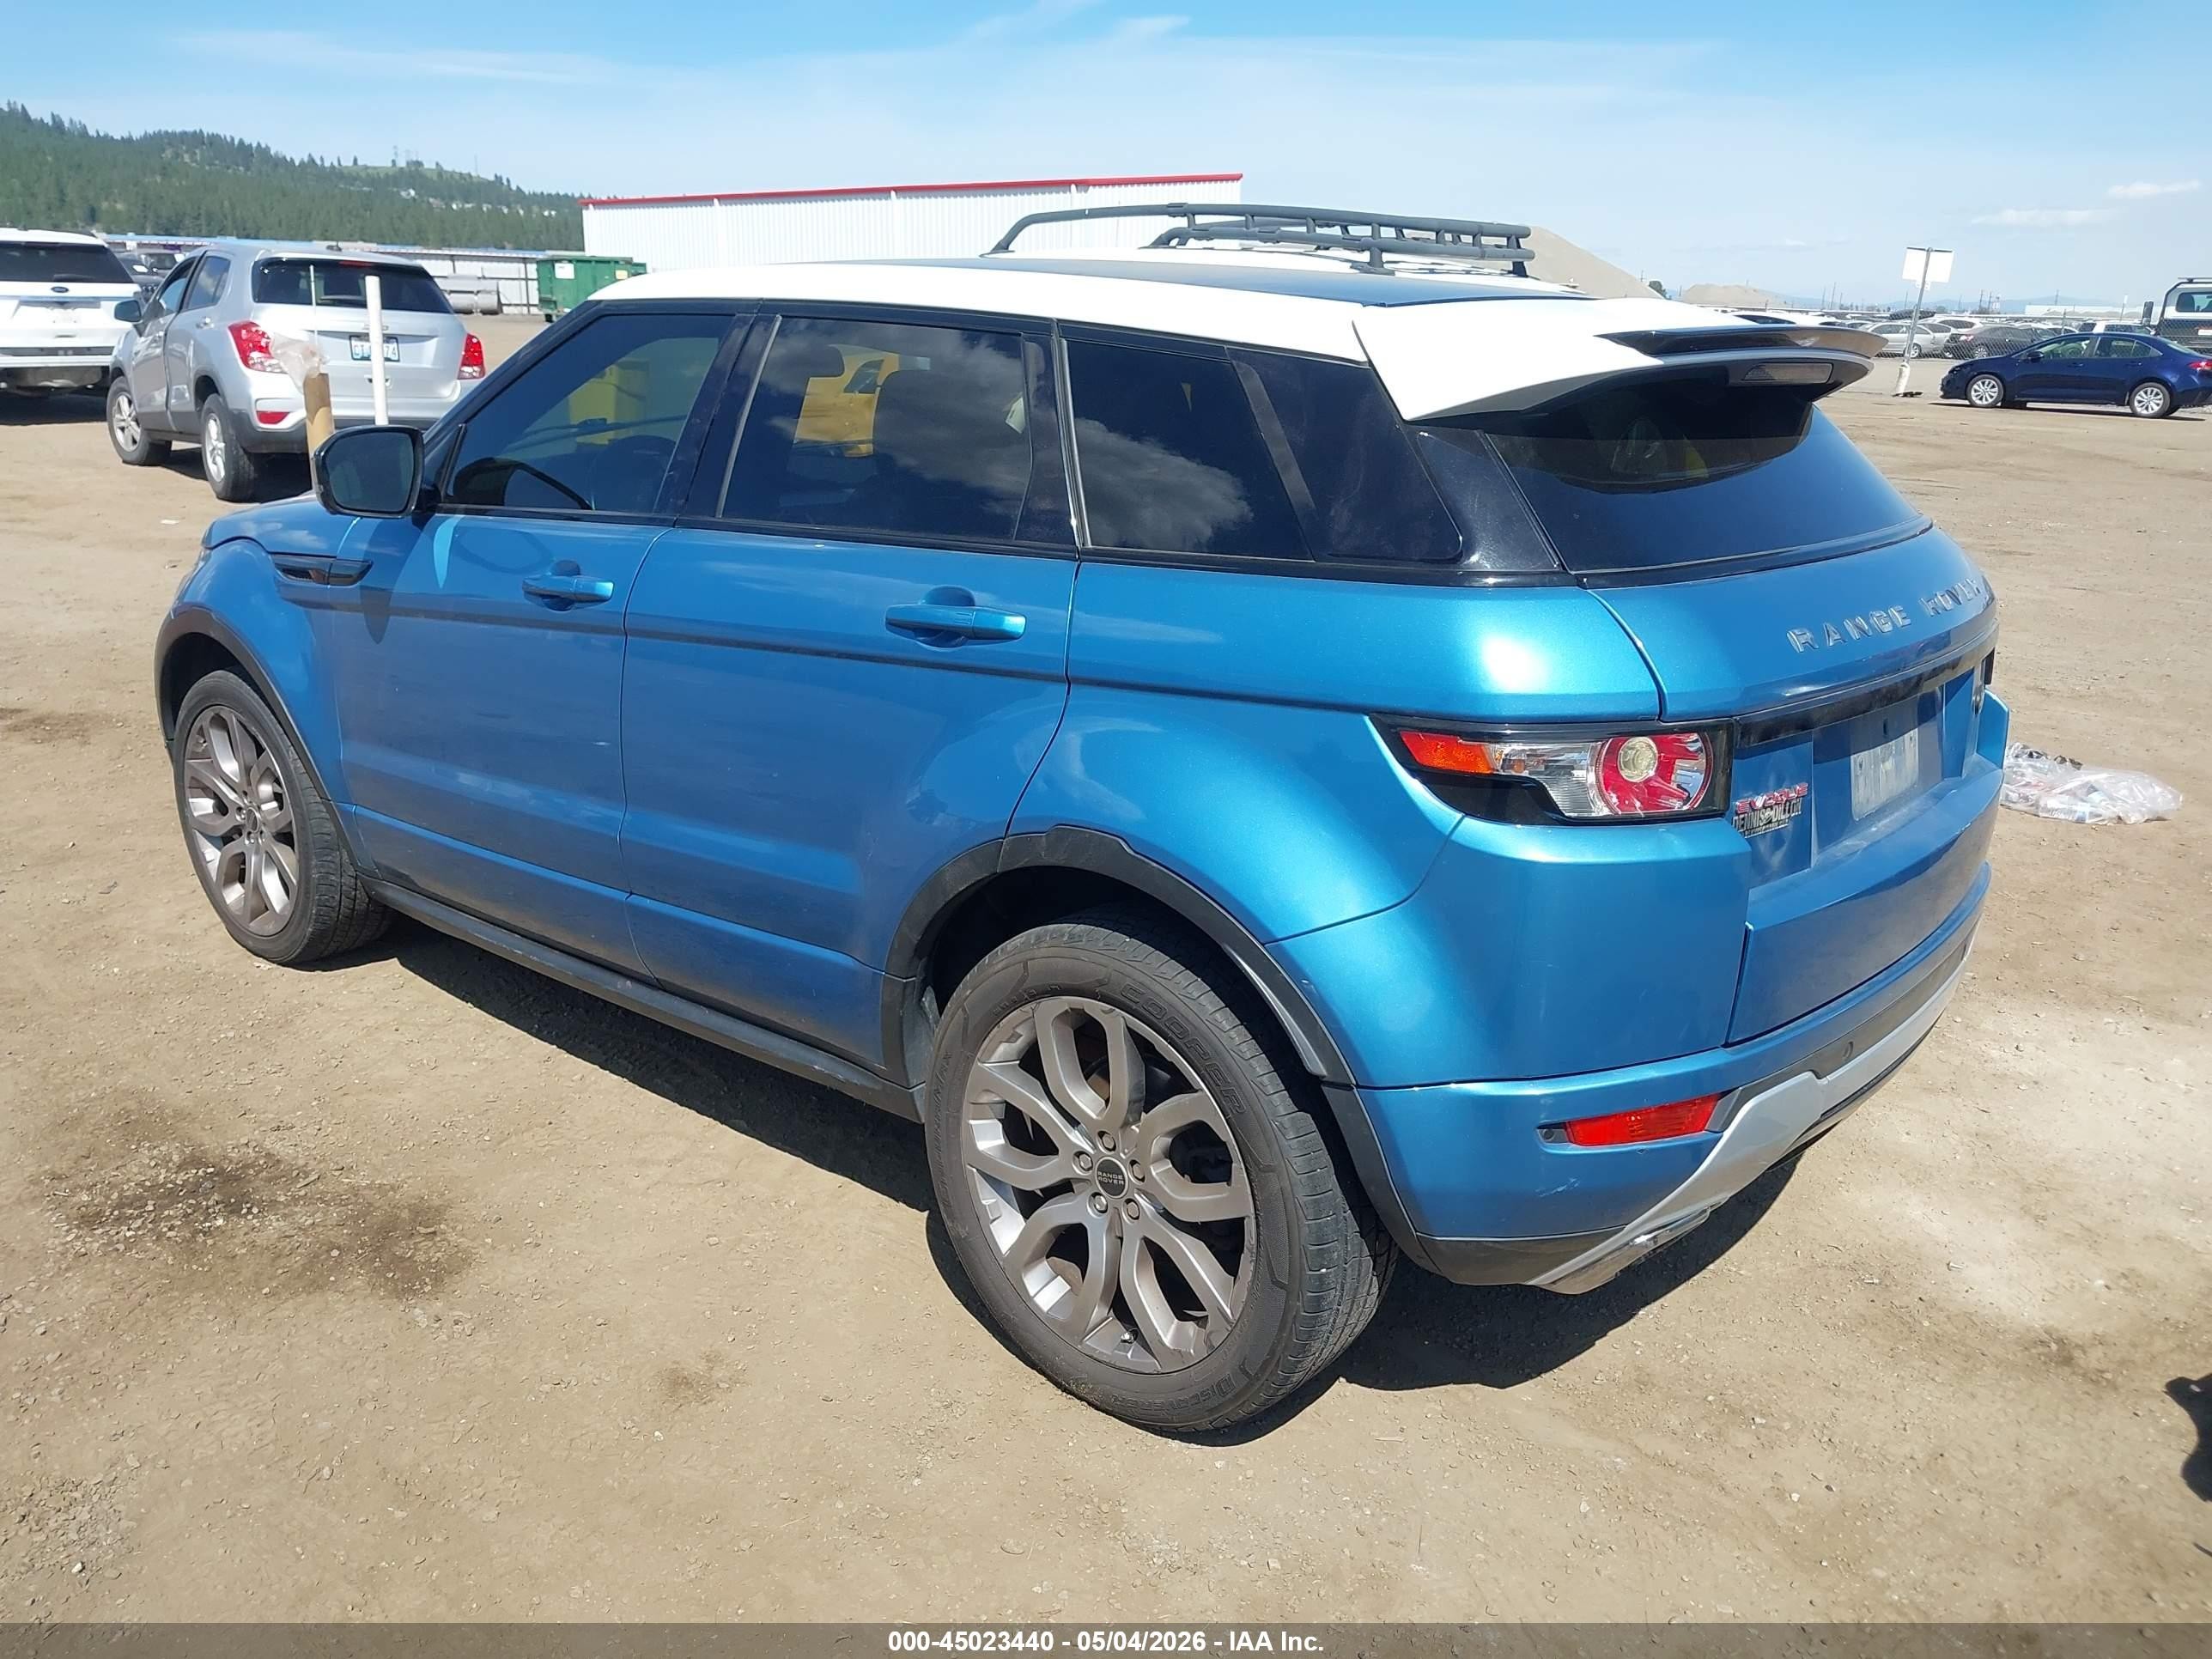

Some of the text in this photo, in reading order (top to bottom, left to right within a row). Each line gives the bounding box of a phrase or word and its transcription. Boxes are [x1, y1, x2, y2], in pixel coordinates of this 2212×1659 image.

[1786, 576, 1982, 653] RANGE ROVER
[1735, 782, 1808, 814] EVOQUE
[1120, 982, 1248, 1115] COOPER
[1097, 1170, 1123, 1180] RANGE
[1097, 1176, 1125, 1186] ROVER
